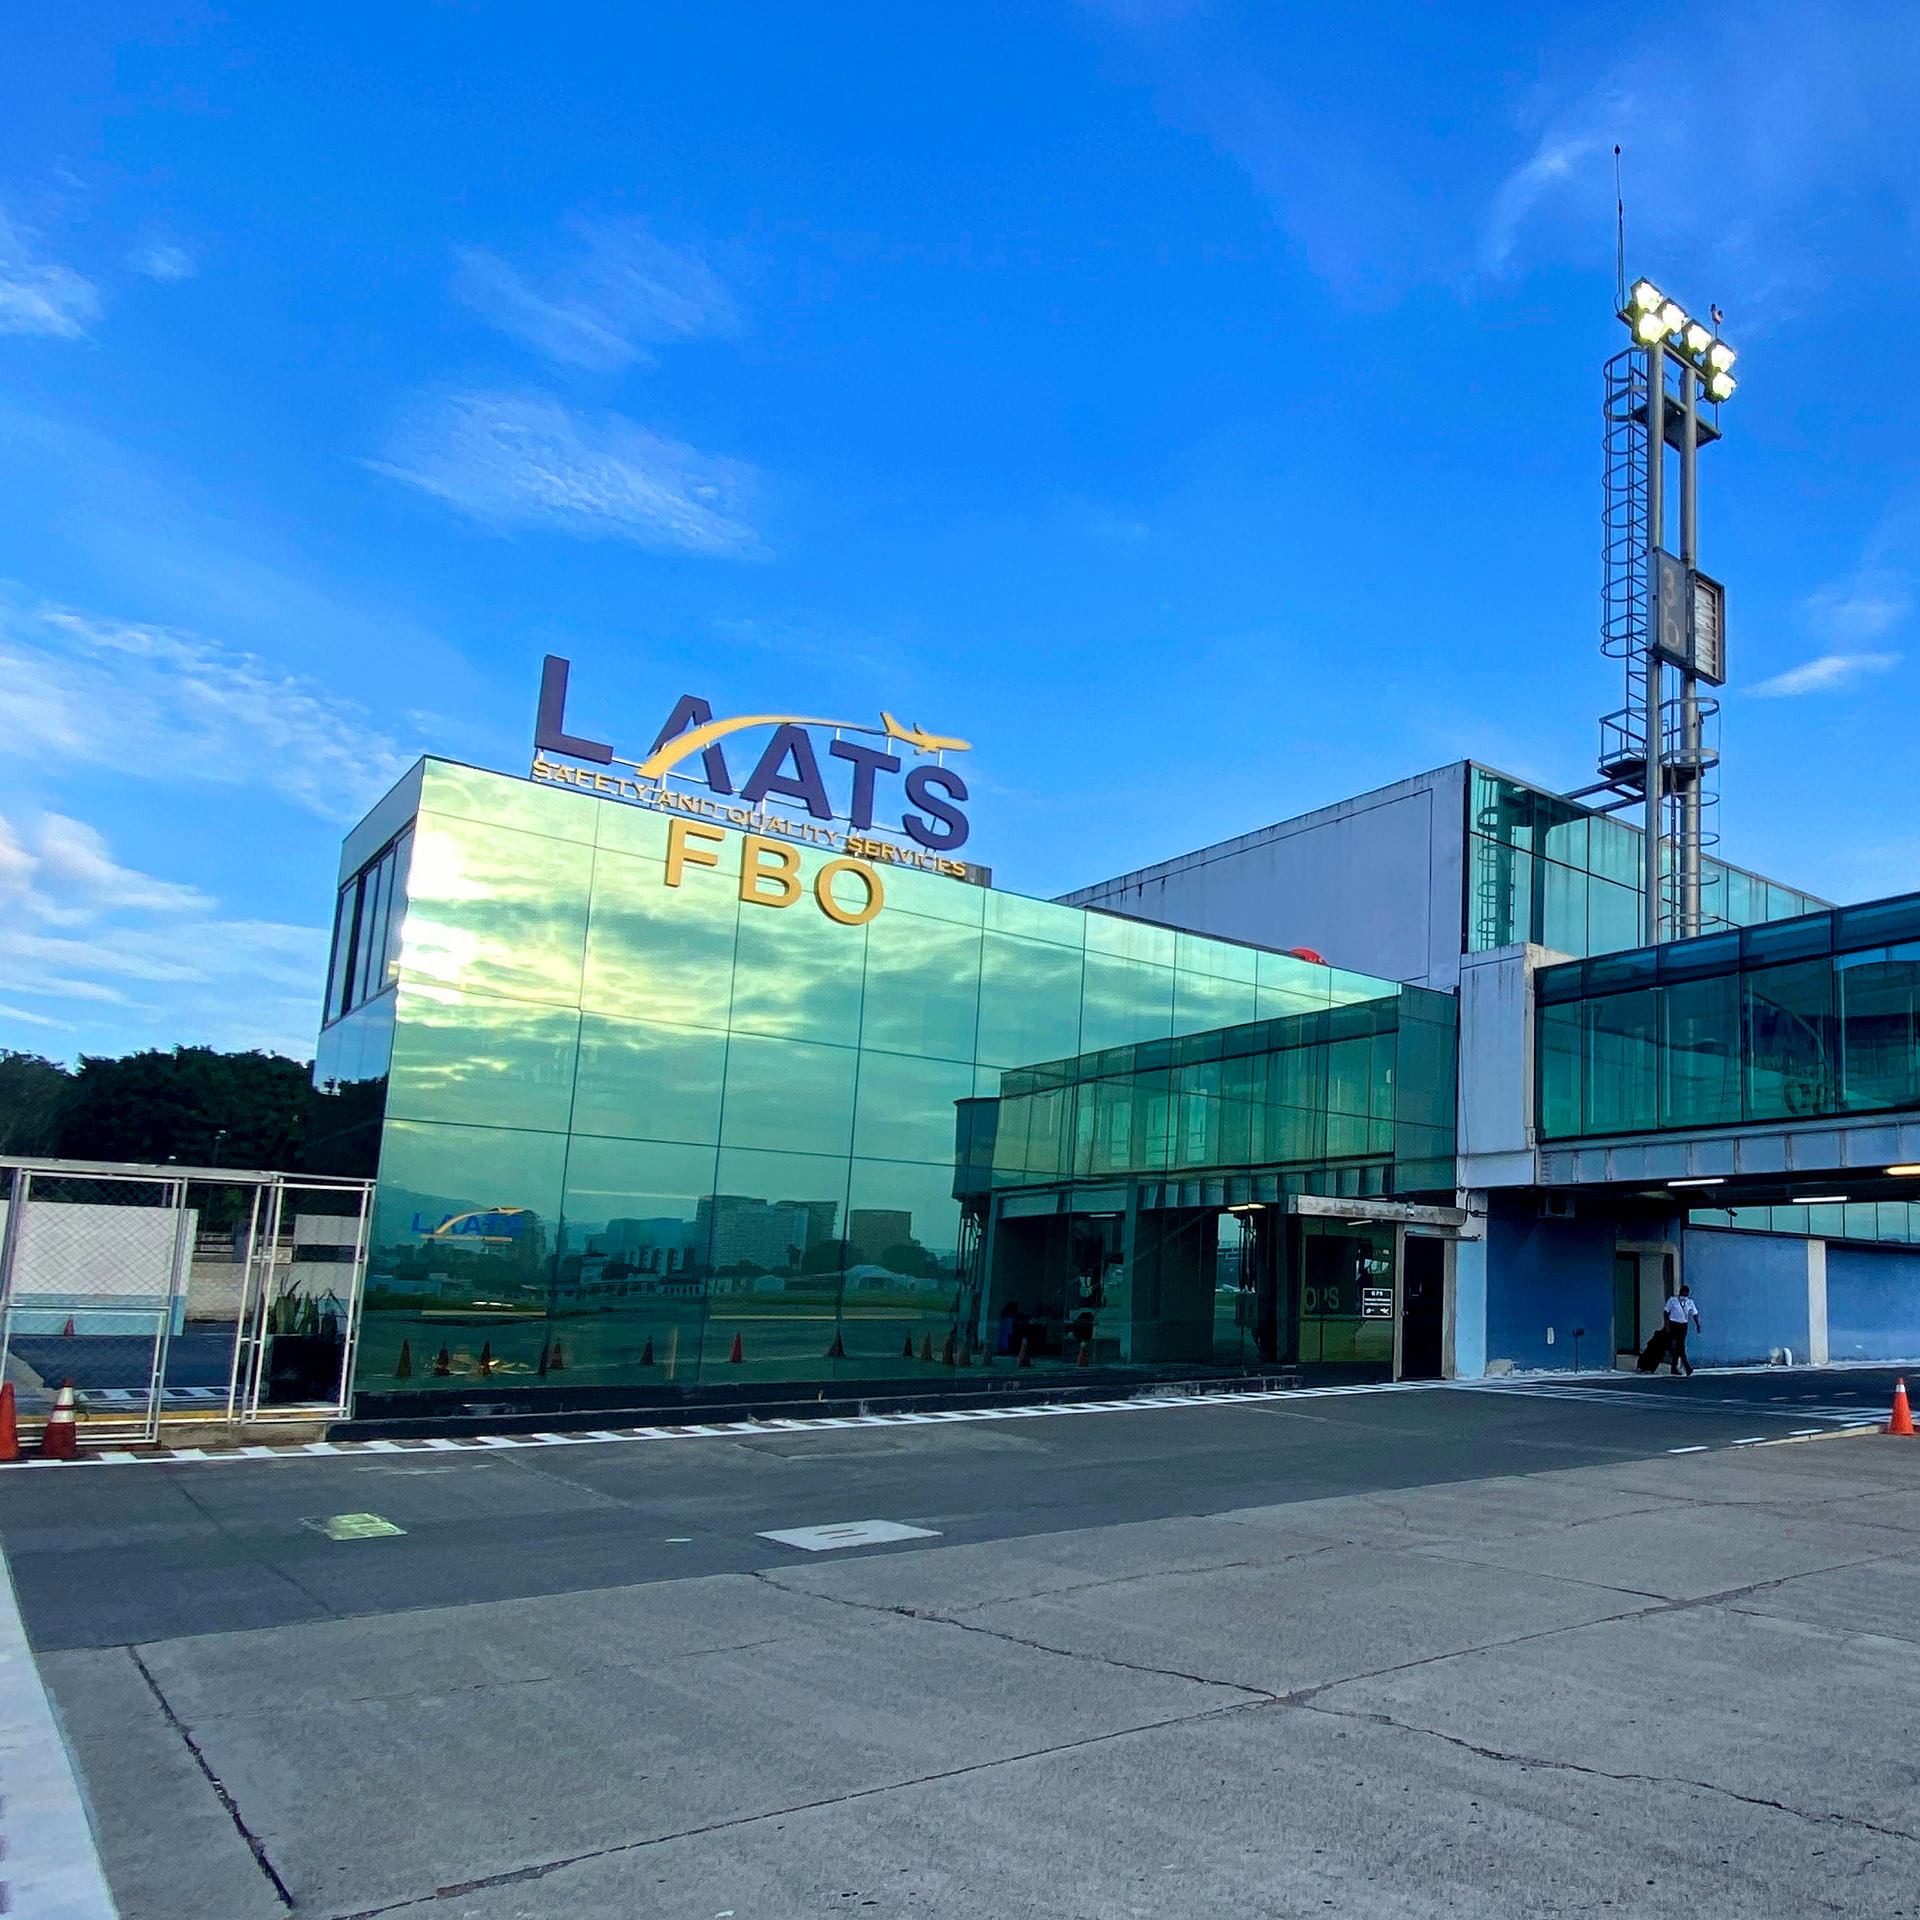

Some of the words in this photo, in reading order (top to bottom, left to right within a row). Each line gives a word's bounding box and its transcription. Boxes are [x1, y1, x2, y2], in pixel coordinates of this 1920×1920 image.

[534, 653, 970, 851] LAATS
[531, 759, 650, 801] SAFETY
[656, 789, 719, 818] AND
[725, 806, 838, 846] QUALITY
[846, 836, 967, 879] SERVICES
[663, 817, 884, 926] FBO
